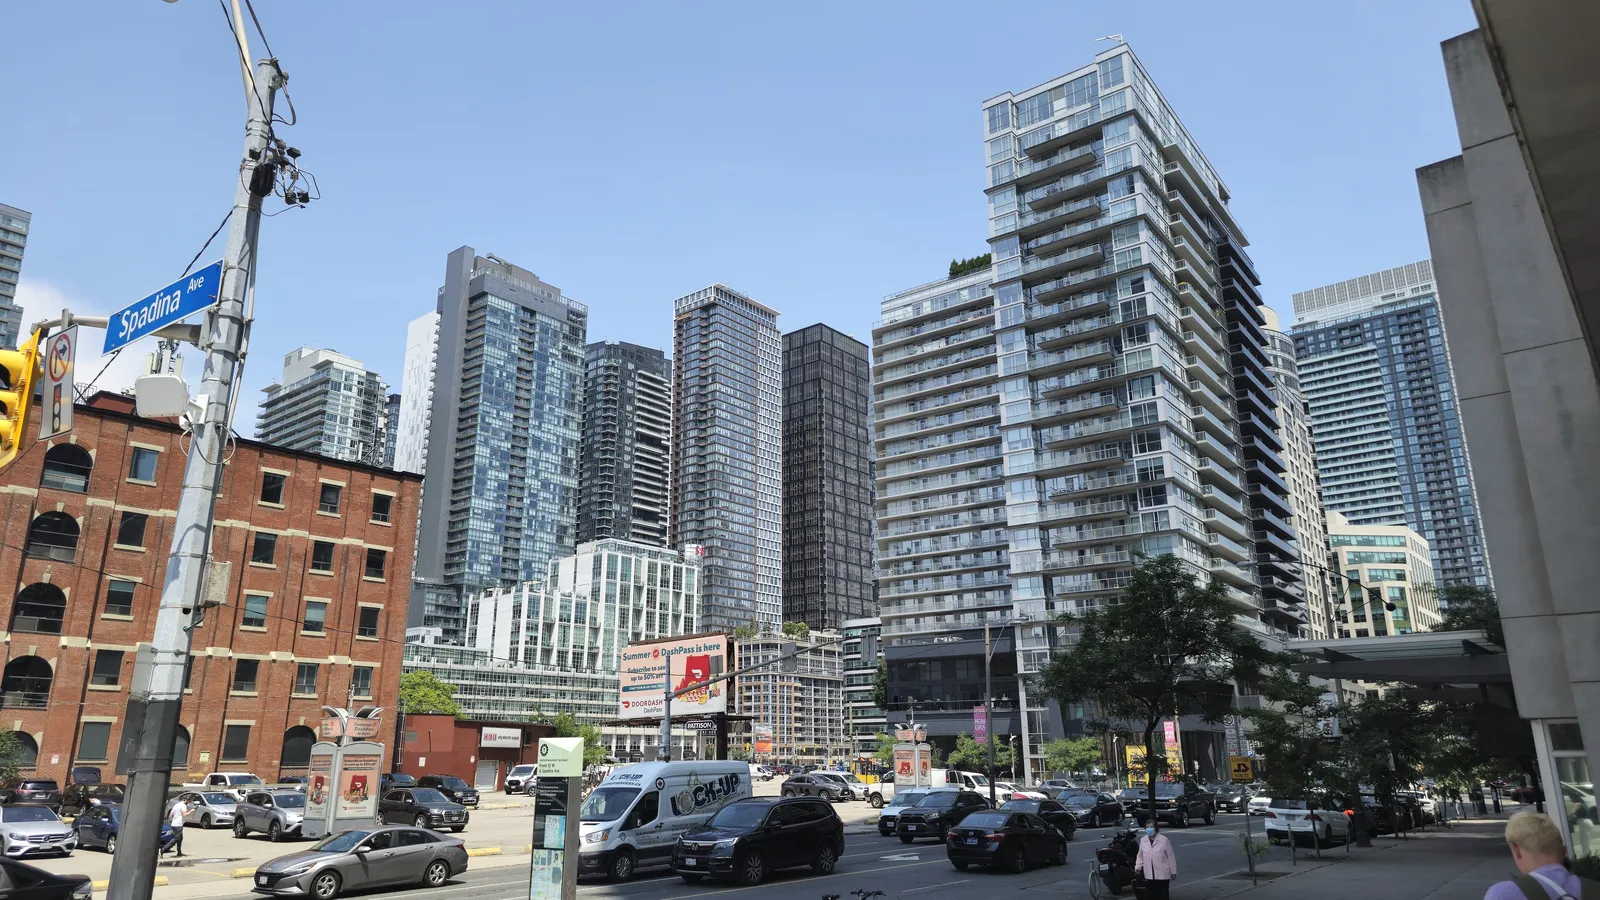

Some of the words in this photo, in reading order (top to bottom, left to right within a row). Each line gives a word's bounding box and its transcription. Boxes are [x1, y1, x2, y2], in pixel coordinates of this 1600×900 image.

[119, 290, 181, 341] Spadina
[187, 275, 204, 294] Ave
[623, 652, 650, 661] Summer
[661, 646, 694, 656] DashPass
[696, 644, 702, 652] is
[703, 643, 720, 651] here
[632, 699, 663, 707] DOORDASH
